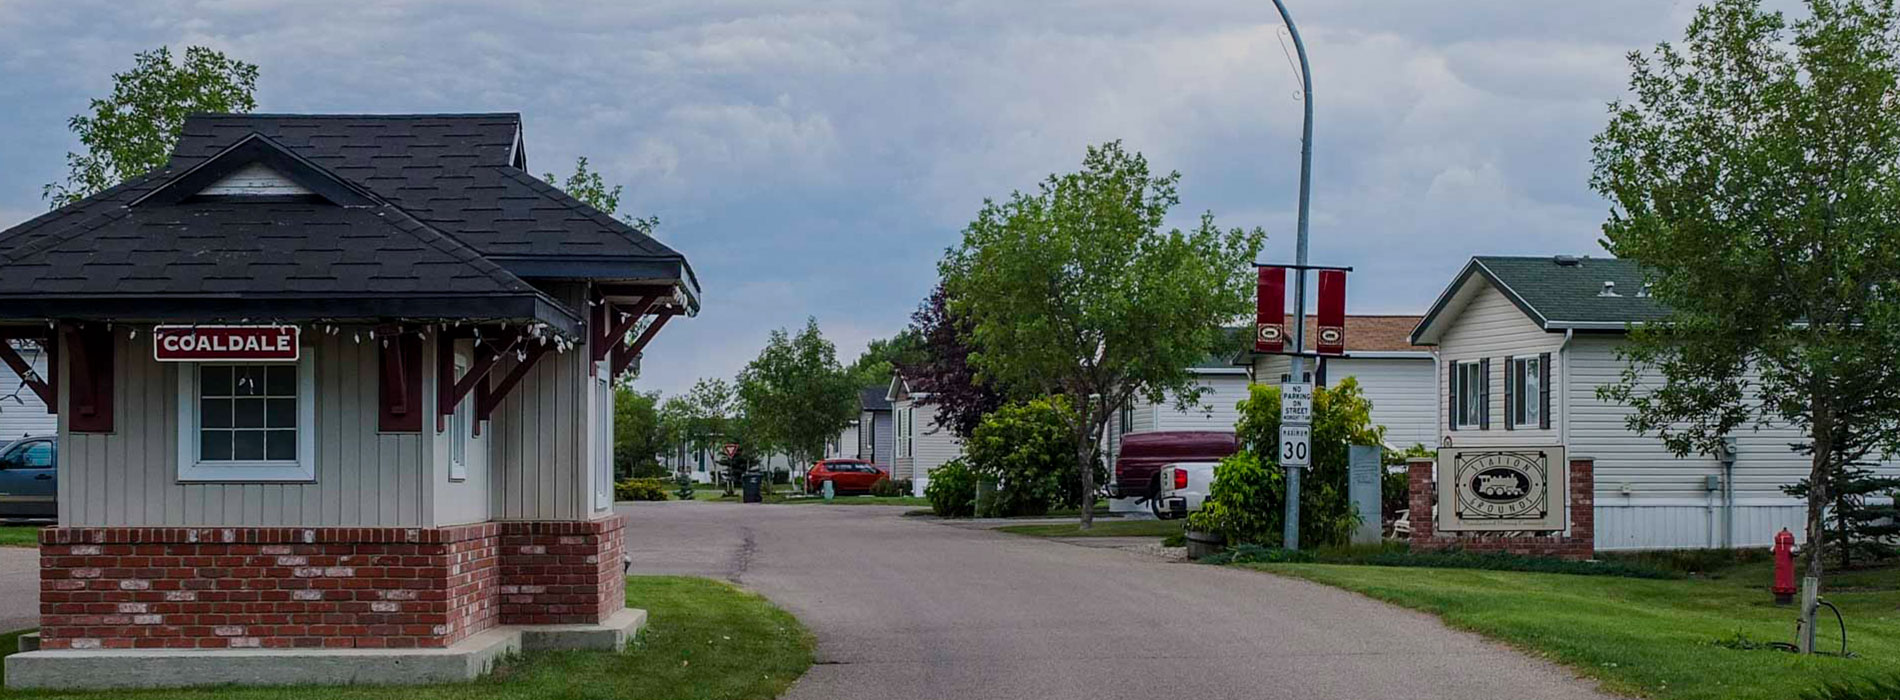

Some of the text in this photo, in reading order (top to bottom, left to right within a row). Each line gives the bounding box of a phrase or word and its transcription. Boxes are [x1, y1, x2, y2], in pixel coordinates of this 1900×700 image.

[163, 335, 290, 351] COALDALE
[1283, 441, 1307, 460] 30
[1471, 457, 1531, 472] STATION
[1470, 497, 1533, 514] GROUNDS
